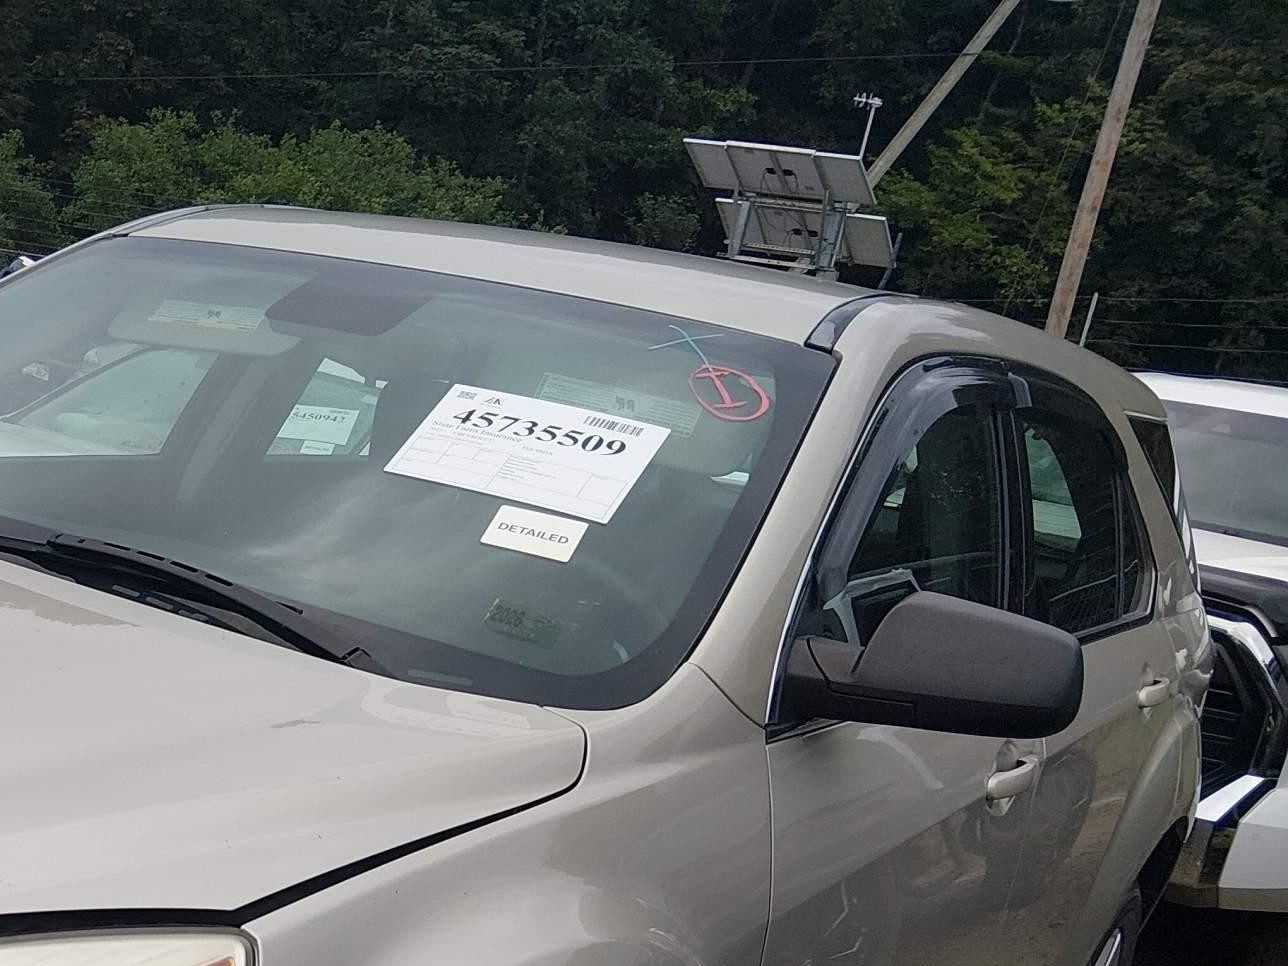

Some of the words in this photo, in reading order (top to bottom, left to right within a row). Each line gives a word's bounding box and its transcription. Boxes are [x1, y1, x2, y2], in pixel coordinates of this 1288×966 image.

[432, 419, 456, 429] State
[455, 422, 479, 434] Farm
[479, 428, 523, 443] Insurance
[452, 408, 628, 457] 45735509
[497, 521, 570, 545] DETAILED
